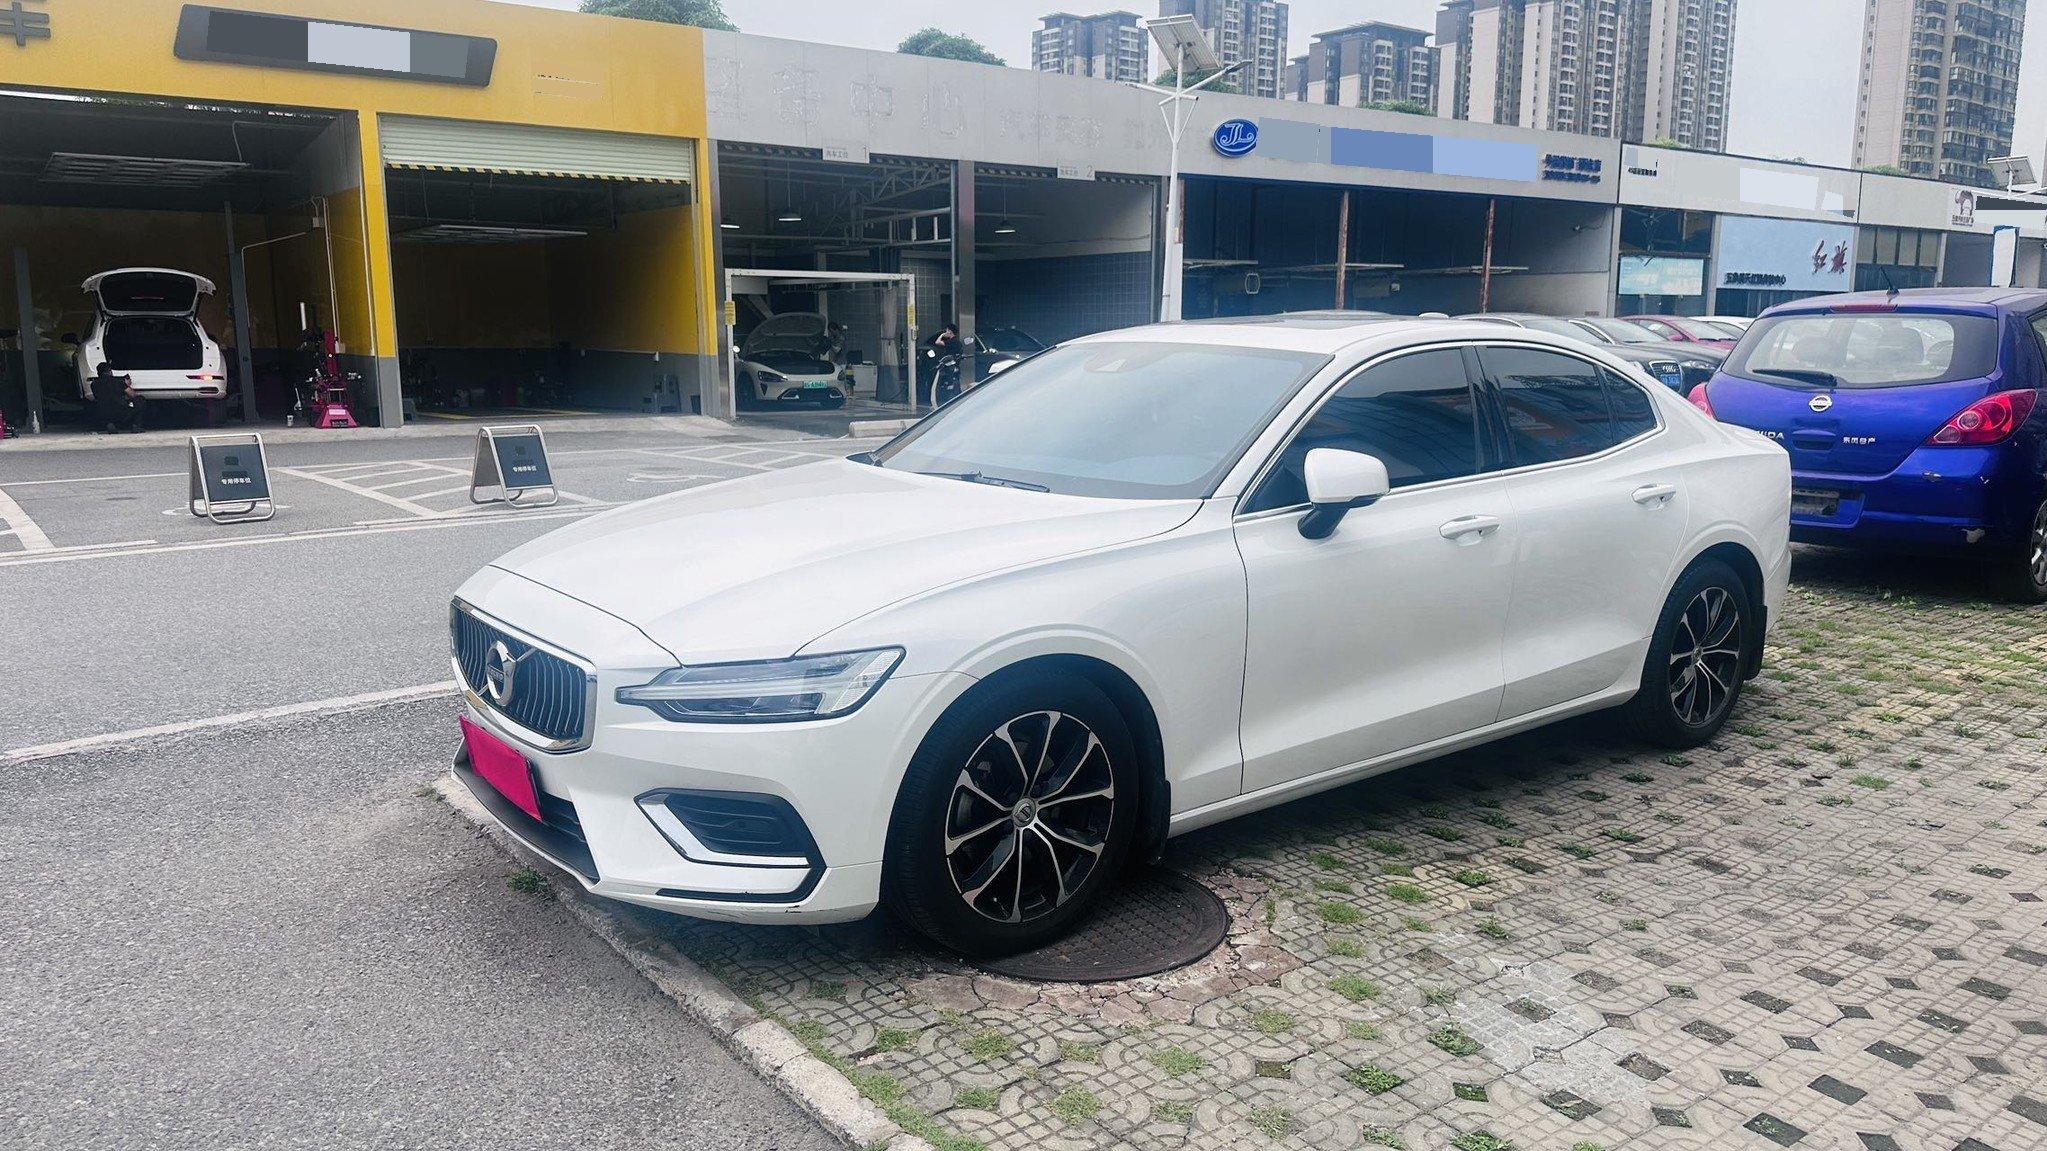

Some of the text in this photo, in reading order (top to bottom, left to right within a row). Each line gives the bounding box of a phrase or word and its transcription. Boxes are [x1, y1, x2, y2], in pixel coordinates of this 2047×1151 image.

[221, 477, 252, 485] 专用停车位
